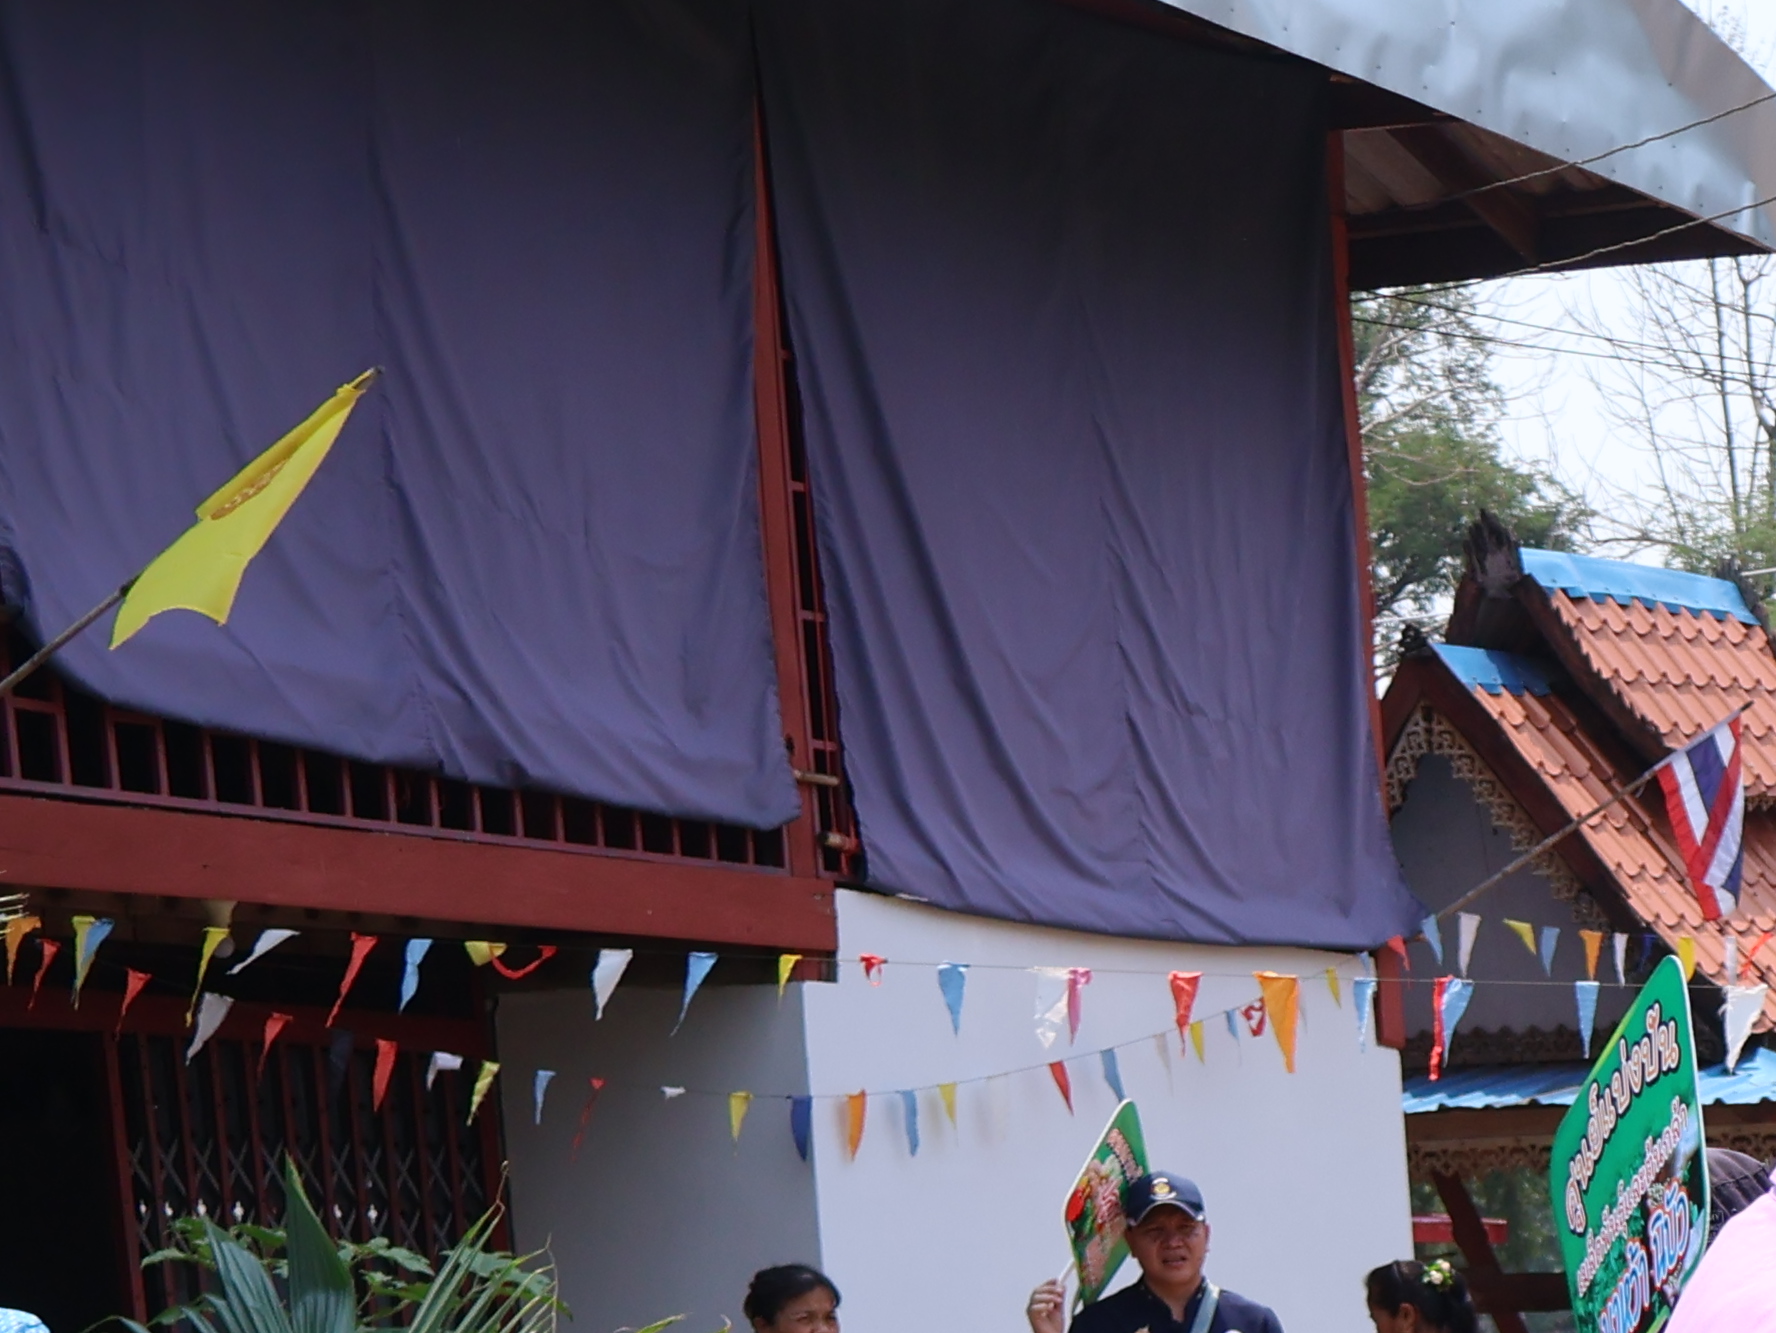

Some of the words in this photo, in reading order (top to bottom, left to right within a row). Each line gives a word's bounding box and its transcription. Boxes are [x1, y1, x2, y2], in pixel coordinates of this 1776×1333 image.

[1565, 1002, 1680, 1232] ศูนย์แบ่งปัน
